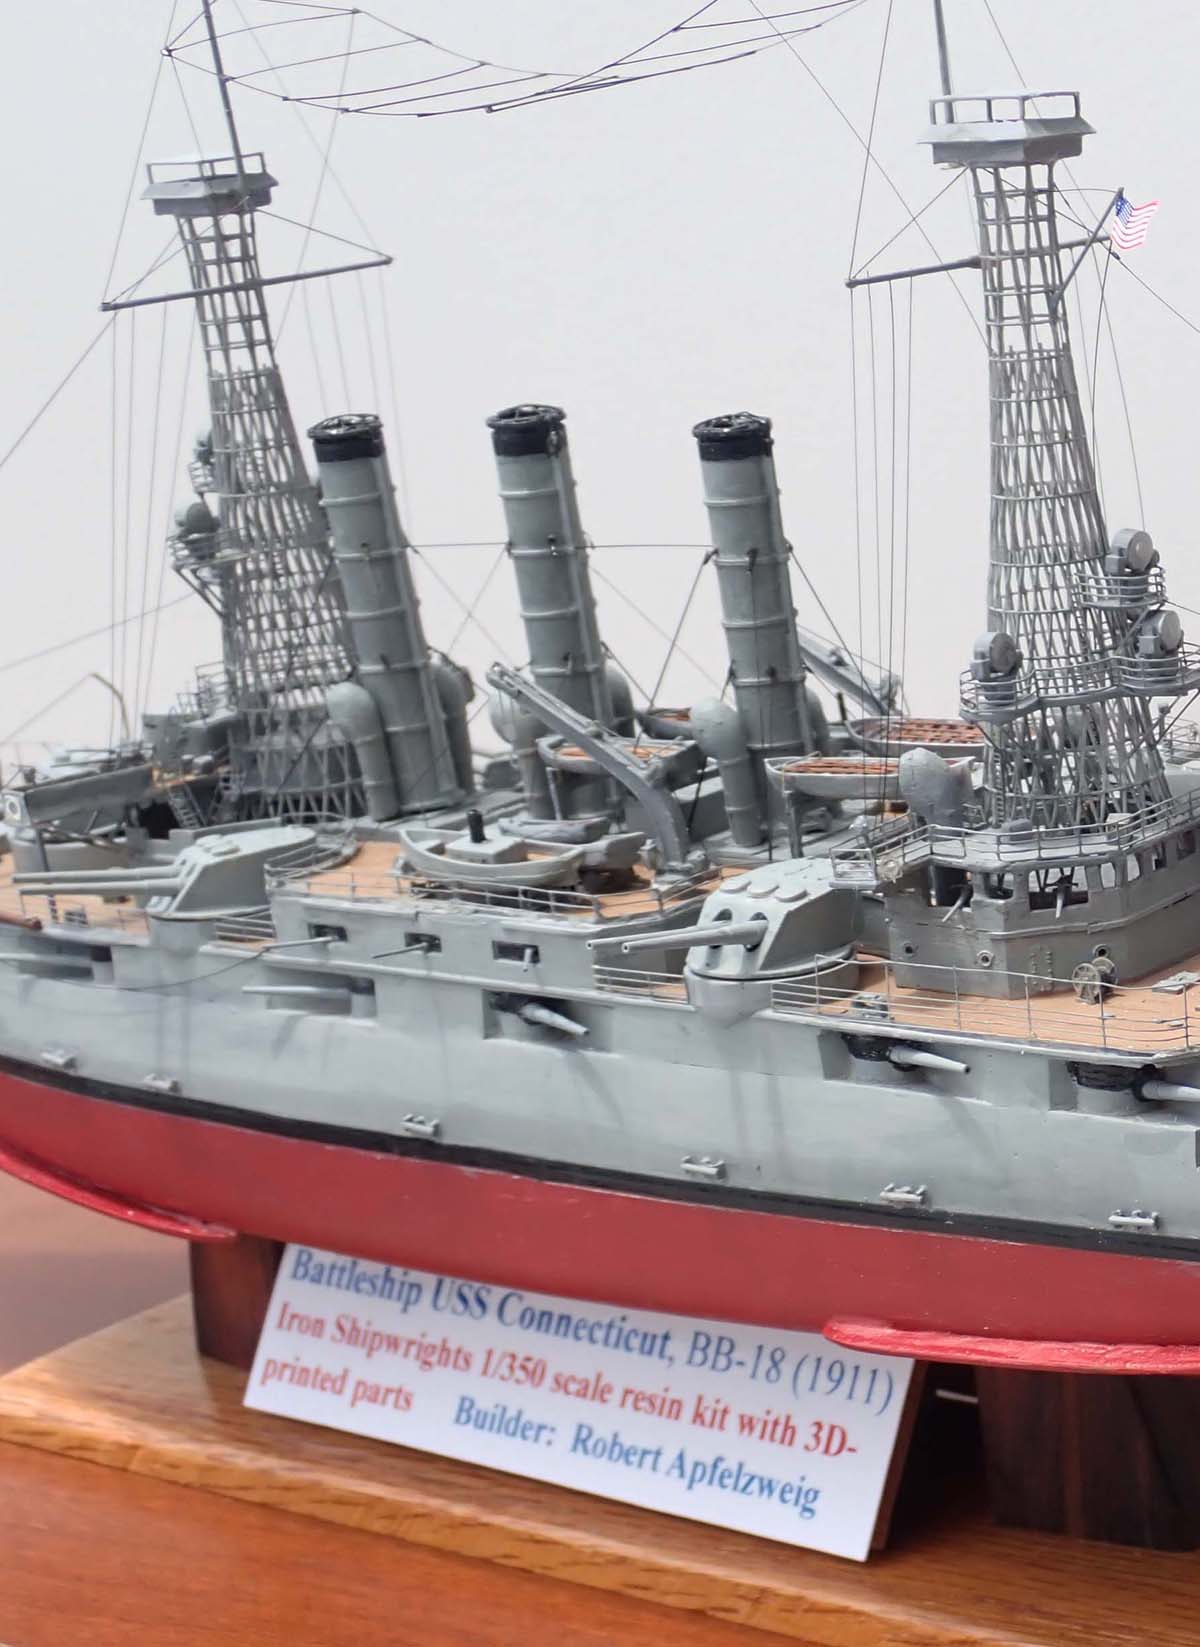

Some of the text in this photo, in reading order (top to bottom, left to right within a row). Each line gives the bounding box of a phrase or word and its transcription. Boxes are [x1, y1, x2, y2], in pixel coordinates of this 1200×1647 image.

[260, 1356, 415, 1411] printed parts
[276, 1301, 858, 1457] Iron Shipwrights 1/350 scale resin kit with 3D-
[291, 1249, 896, 1416] Battleship USS Connecticut, BB-18 (1911)
[454, 1395, 821, 1519] Builder: Robert Apfelzweig
